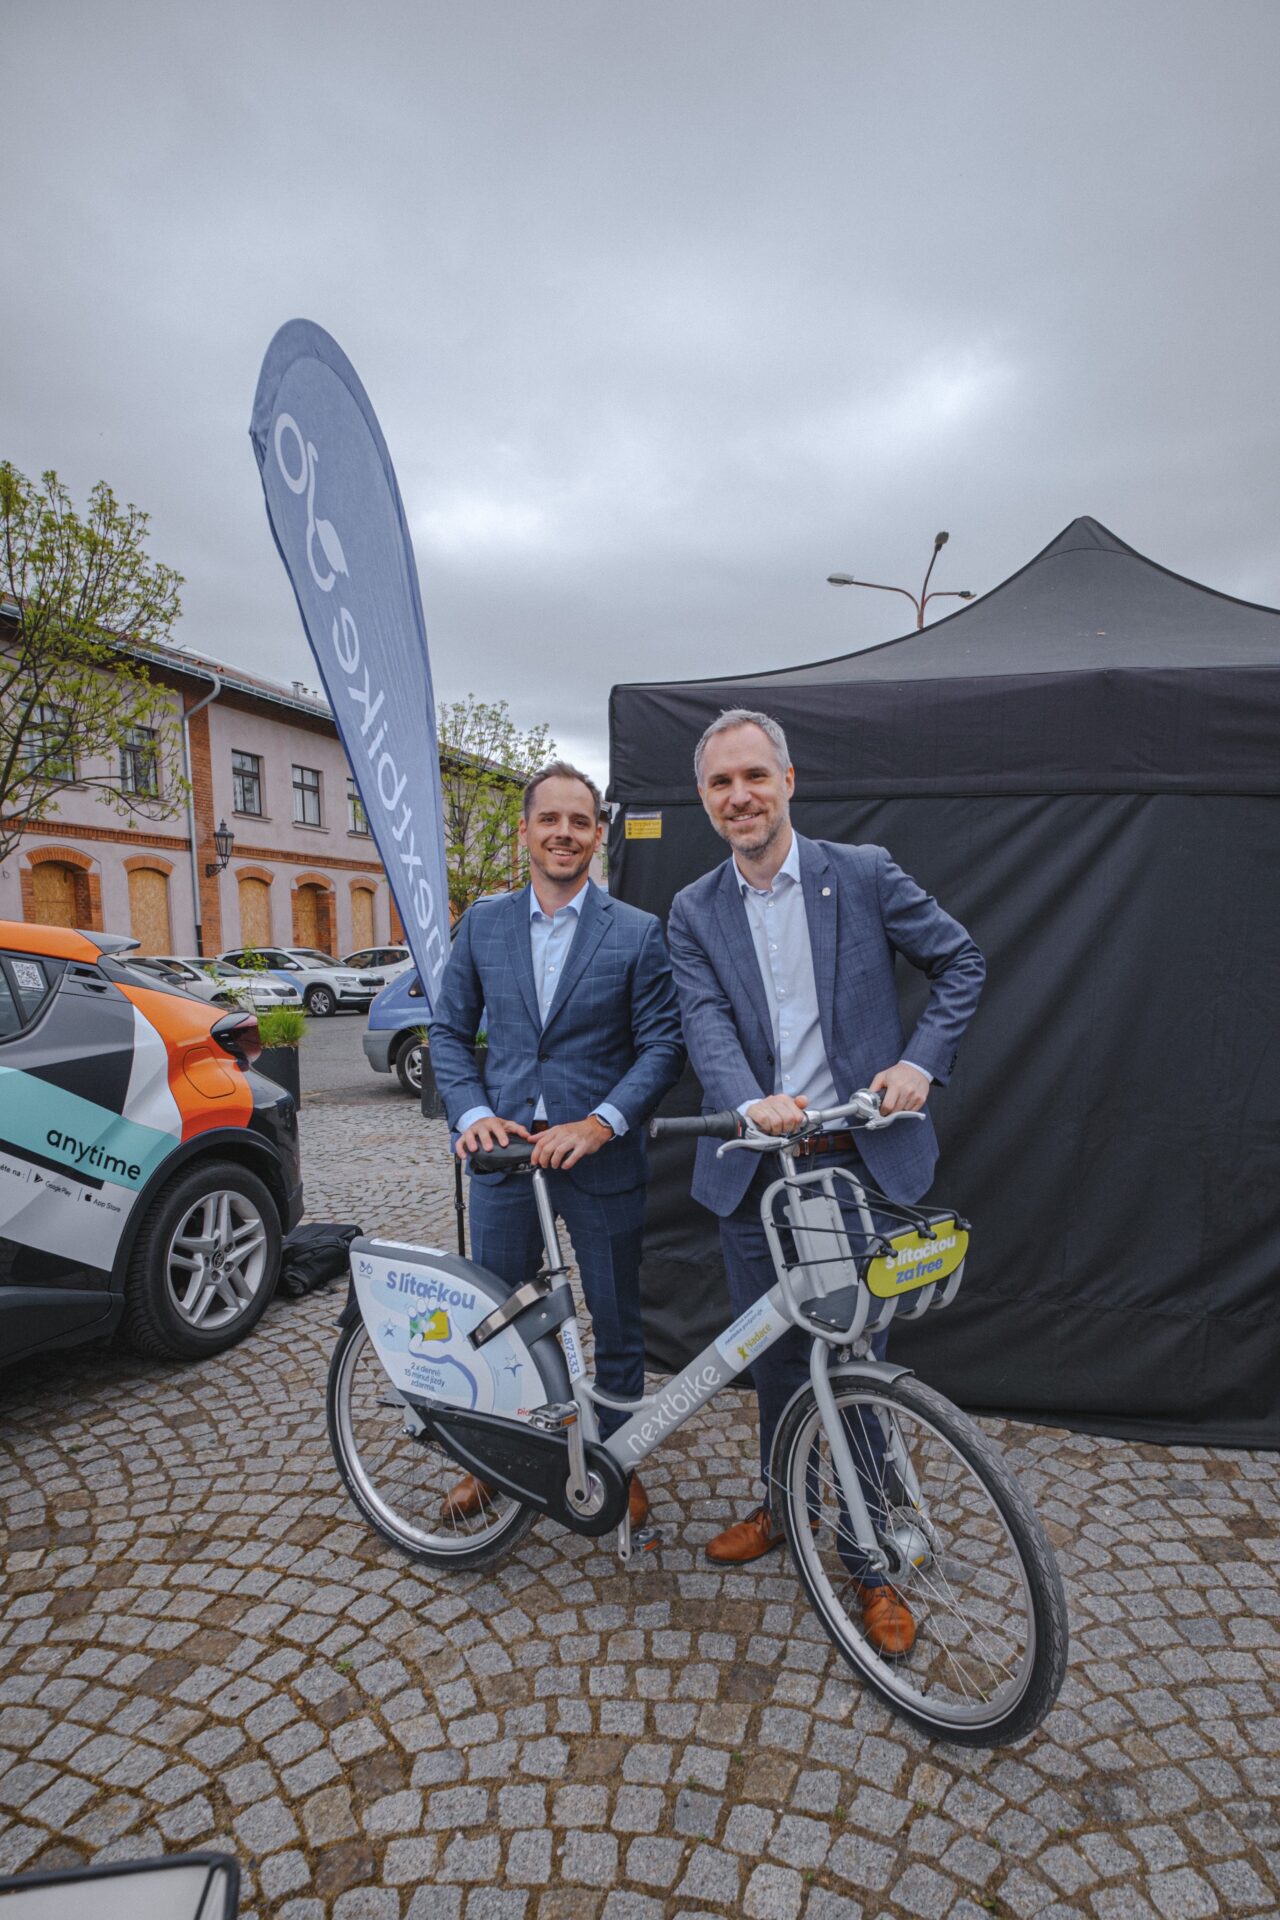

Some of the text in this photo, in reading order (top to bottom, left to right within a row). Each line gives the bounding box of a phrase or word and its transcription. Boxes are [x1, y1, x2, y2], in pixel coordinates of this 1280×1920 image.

[47, 1129, 141, 1180] anytime
[93, 1199, 121, 1213] App Store
[897, 1235, 956, 1266] lítačkou
[386, 1270, 476, 1310] S lítačkou
[896, 1258, 943, 1284] za free
[563, 1330, 580, 1374] 487333
[627, 1366, 720, 1454] nextbike
